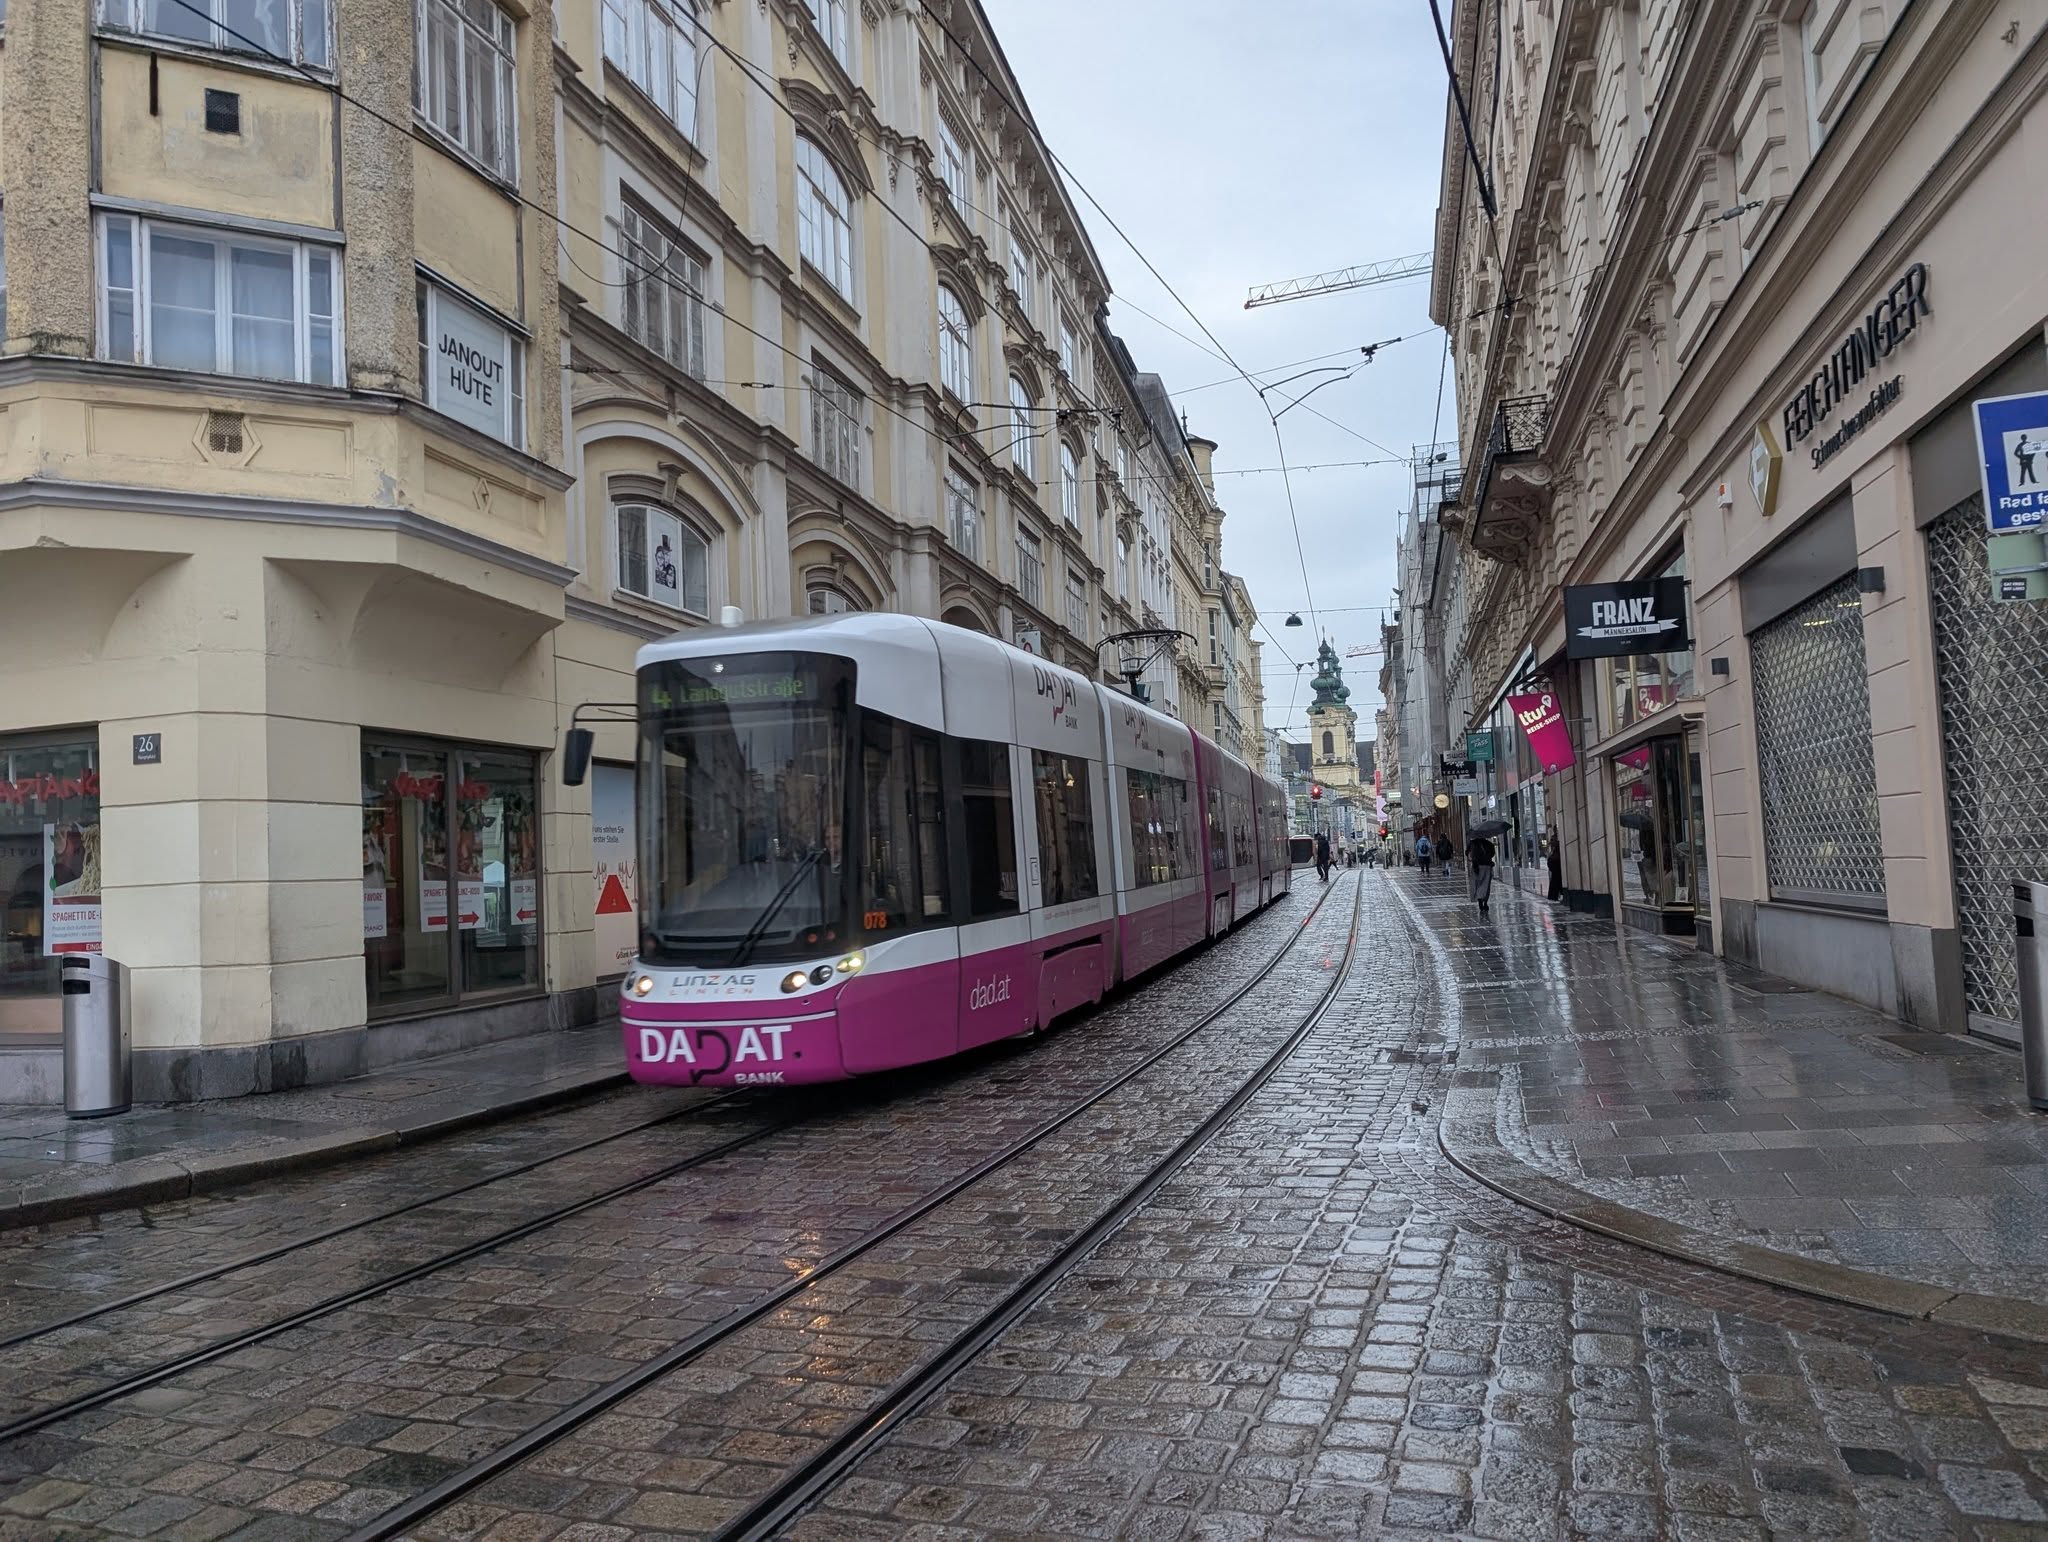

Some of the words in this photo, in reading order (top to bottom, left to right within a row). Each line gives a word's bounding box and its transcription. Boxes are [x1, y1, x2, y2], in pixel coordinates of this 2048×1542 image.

[439, 333, 503, 383] JANOUT
[1783, 262, 1930, 452] FEICHTINGER
[2000, 494, 2032, 509] Rad
[2038, 492, 2048, 505] fa
[2011, 507, 2048, 525] gest
[1592, 597, 1655, 626] FRANZ
[1526, 713, 1561, 735] REISE-SHOP
[139, 735, 153, 752] 26
[424, 887, 448, 898] SPAGHETT
[52, 911, 86, 921] SPAGHETTI
[864, 911, 887, 930] 078
[672, 975, 720, 988] LINZ
[722, 974, 757, 986] AG
[970, 974, 1011, 1010] dad.at
[734, 1071, 785, 1085] BANK
